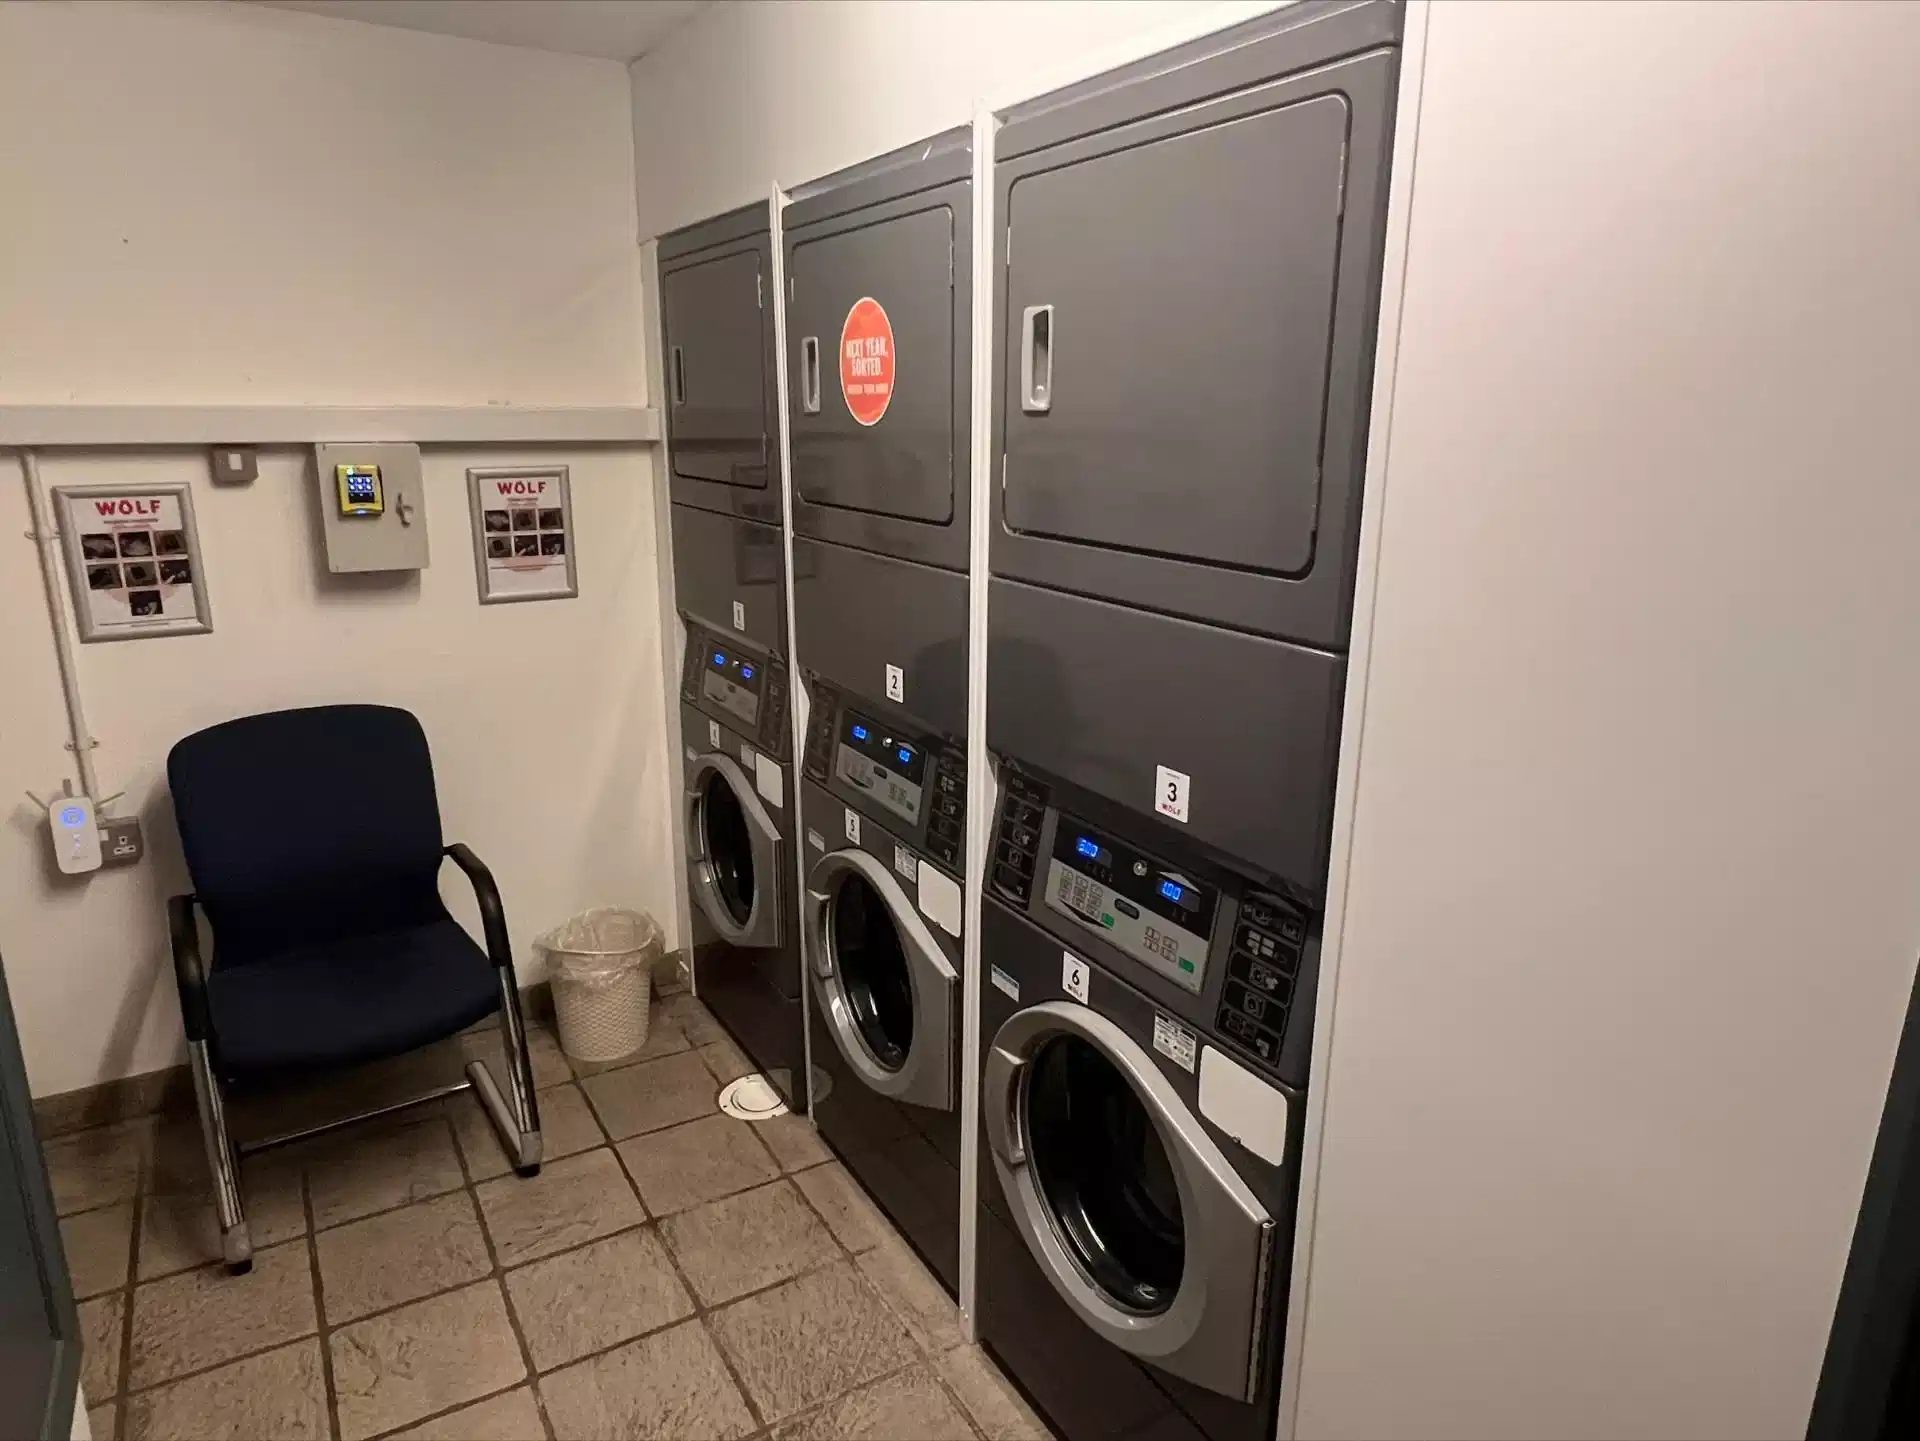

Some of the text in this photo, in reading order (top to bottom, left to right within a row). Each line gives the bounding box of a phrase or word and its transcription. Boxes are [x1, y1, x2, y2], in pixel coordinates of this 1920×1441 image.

[496, 480, 547, 495] WOLF
[94, 499, 161, 516] WOLF
[891, 674, 898, 689] 2
[1167, 782, 1177, 802] 3
[1071, 969, 1080, 986] 6
